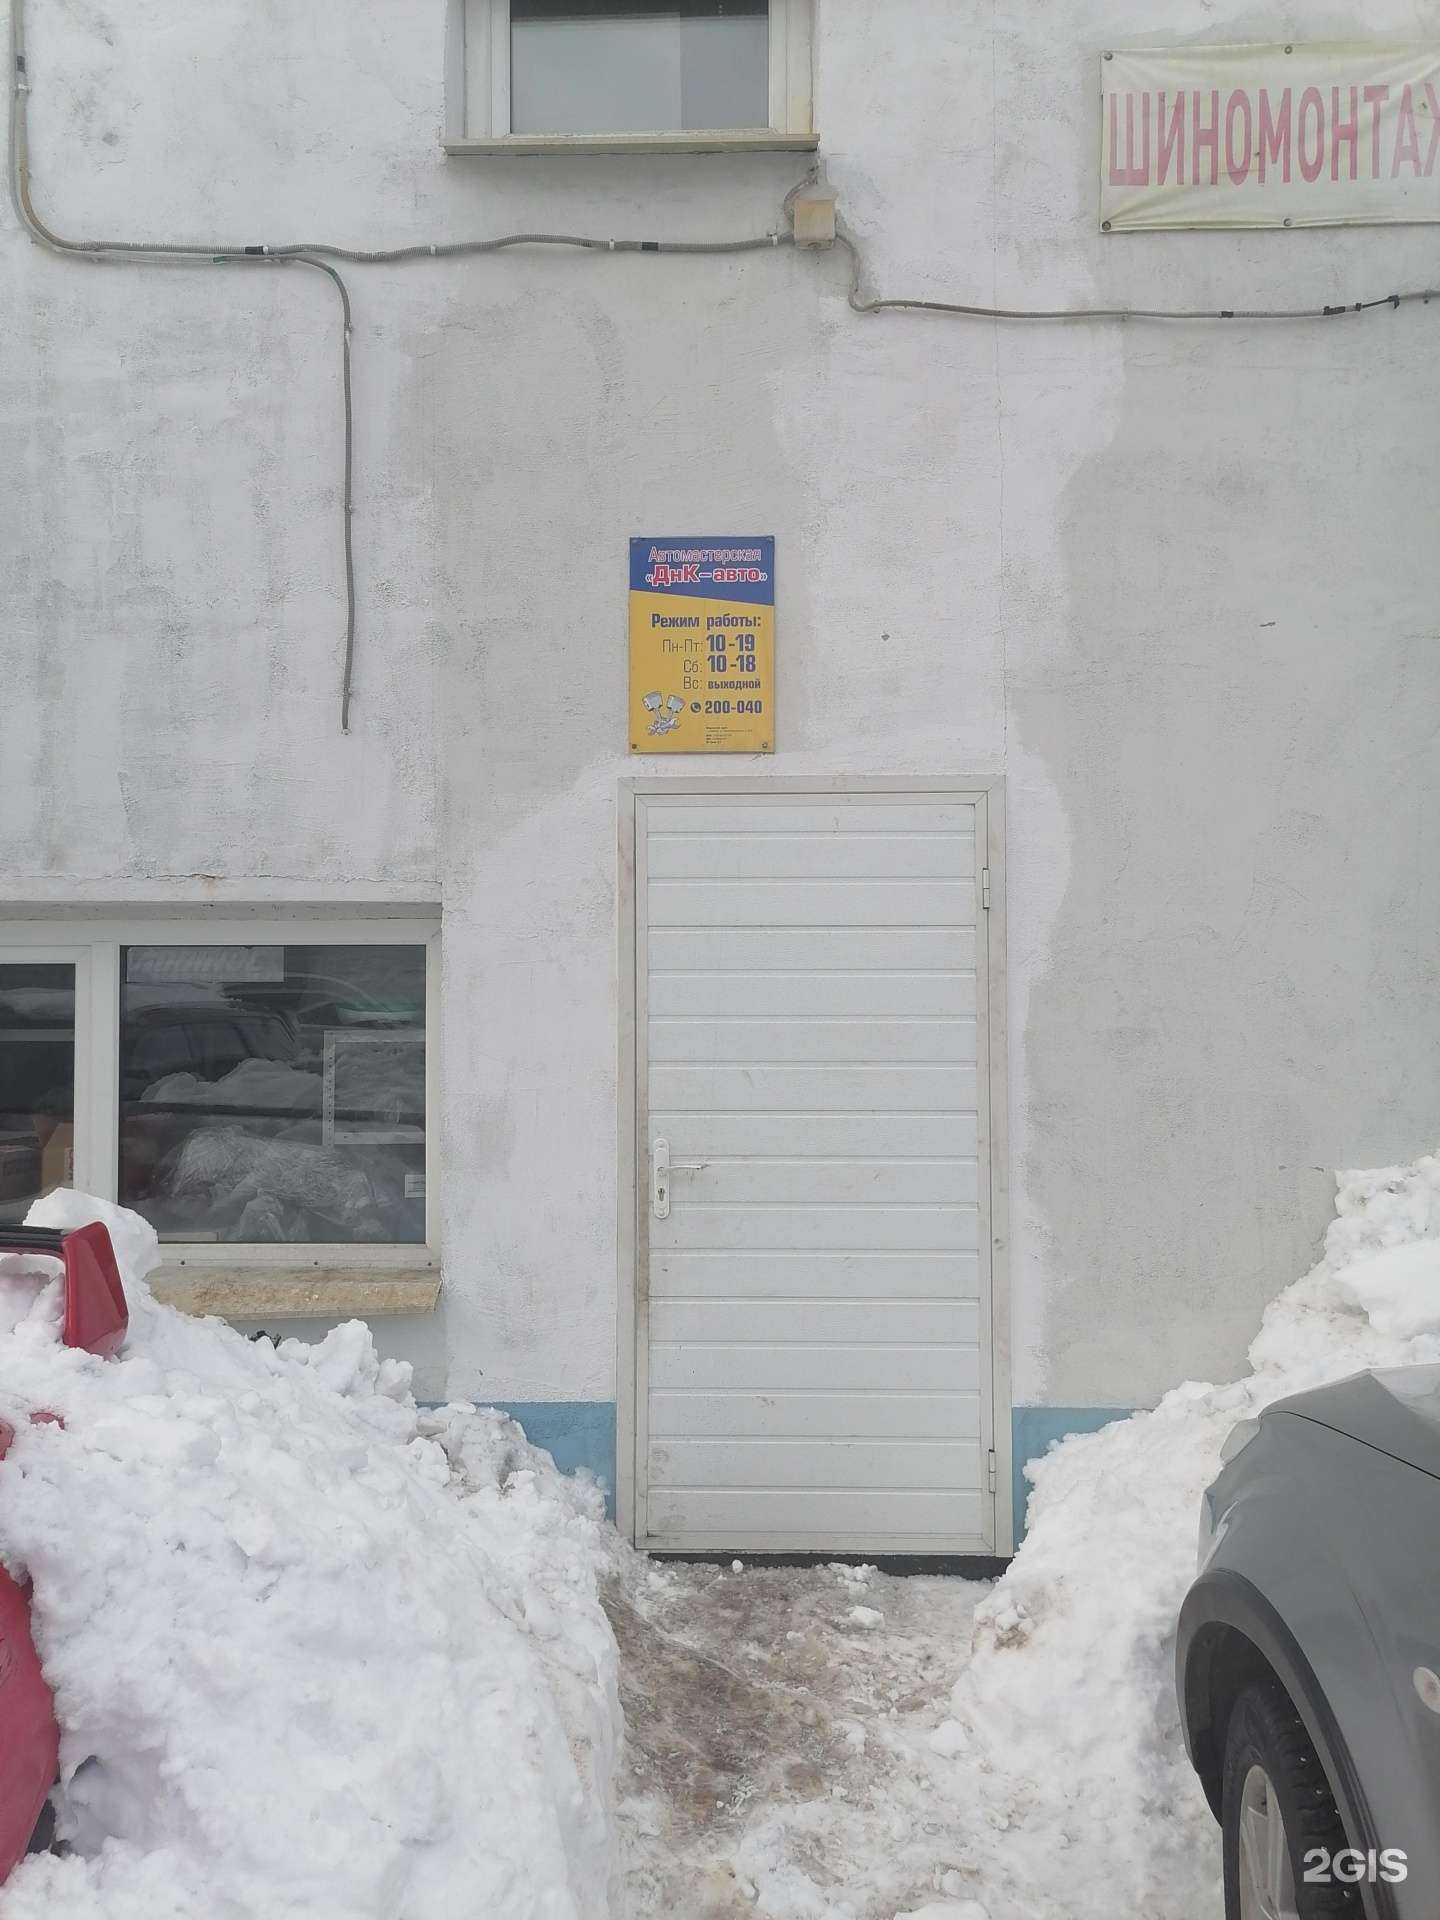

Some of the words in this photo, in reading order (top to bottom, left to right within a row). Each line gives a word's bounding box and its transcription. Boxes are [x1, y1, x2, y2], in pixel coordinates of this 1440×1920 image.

[648, 546, 762, 565] Автомастерская
[651, 613, 700, 628] Режим
[706, 613, 762, 630] работы:
[662, 639, 704, 653] Пн-Пт:
[683, 659, 703, 673] Сб:
[683, 676, 703, 690] Вс:
[707, 678, 761, 690] выходной
[704, 700, 763, 714] 200-040
